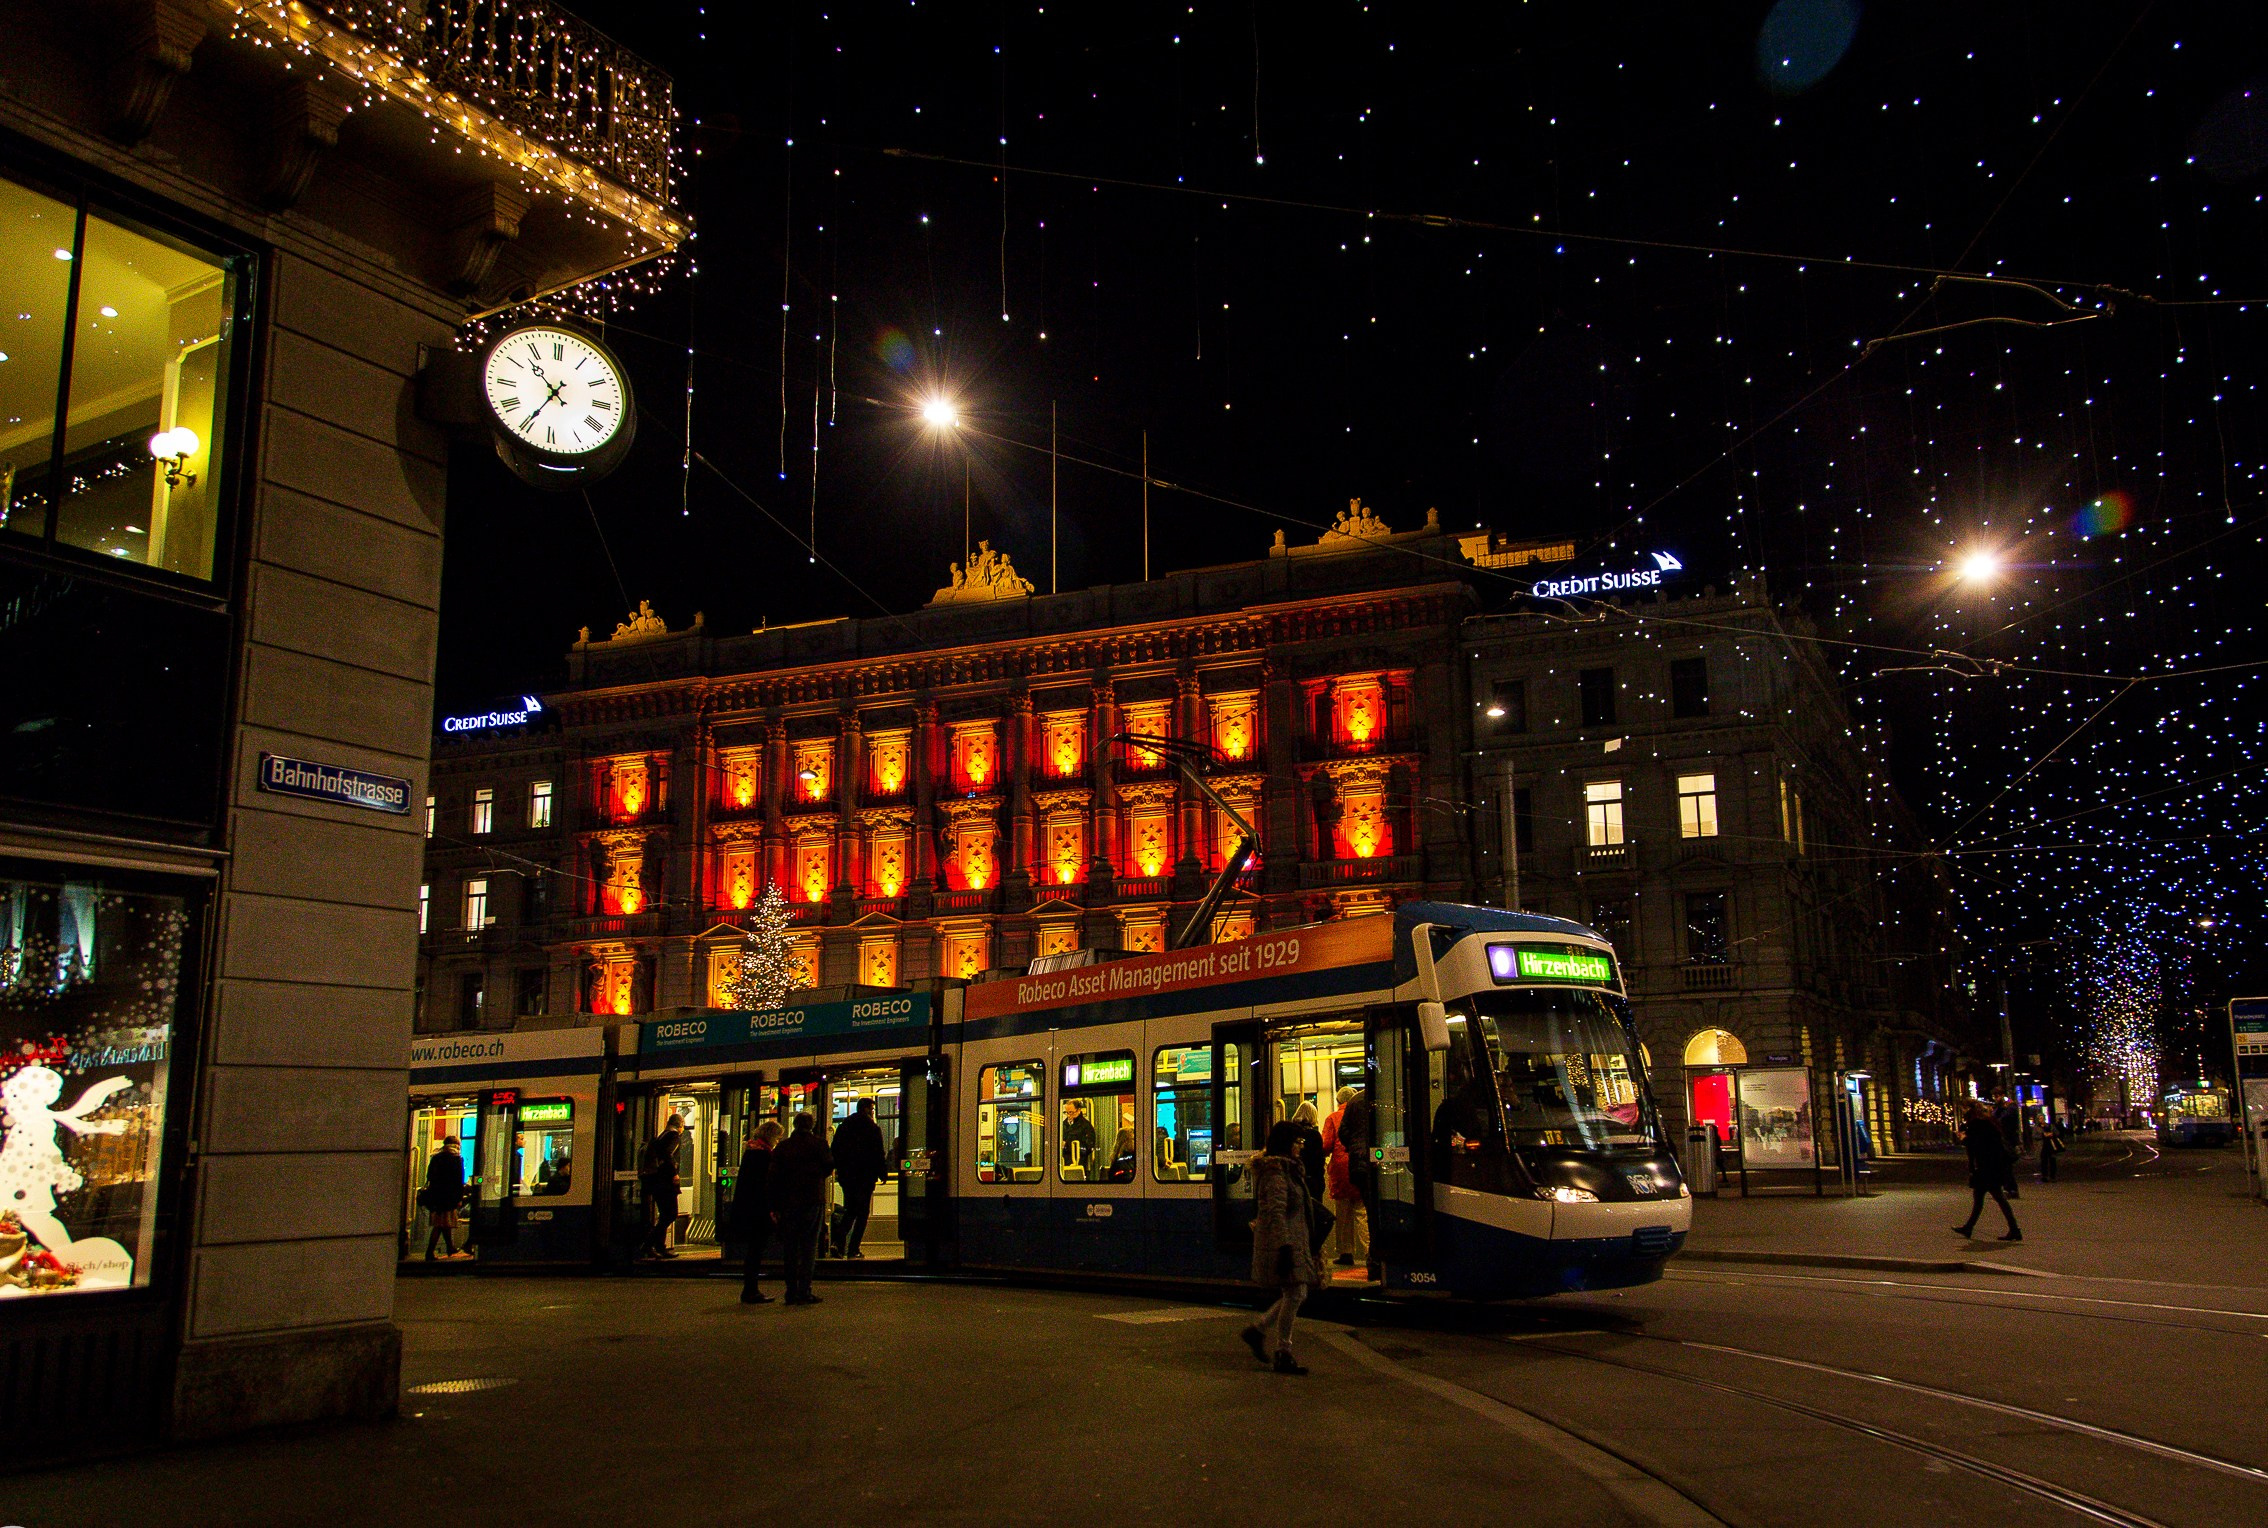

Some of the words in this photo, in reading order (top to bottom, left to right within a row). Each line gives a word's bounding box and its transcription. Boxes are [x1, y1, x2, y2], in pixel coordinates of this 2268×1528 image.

[1532, 577, 1600, 598] CREDIT
[1601, 570, 1662, 590] SUISSE
[444, 715, 489, 732] CREDIT
[488, 711, 528, 727] SUISSE
[272, 760, 403, 804] Bahnhofstrasse
[1017, 976, 1066, 1005] Robeco
[1068, 970, 1106, 998] Asset
[1108, 952, 1216, 990] Management
[1218, 948, 1252, 976] seit
[1255, 938, 1300, 970] 1929
[1523, 953, 1606, 979] Hirzenbach
[852, 1000, 912, 1018] ROBECO
[656, 1021, 707, 1038] ROBECO
[750, 1011, 805, 1029] ROBECO
[411, 1038, 504, 1062] ww.robeco.ch
[1083, 1061, 1129, 1082] Hirzenbach
[522, 1105, 568, 1121] Hirzenbach
[1410, 1272, 1437, 1283] 3054
